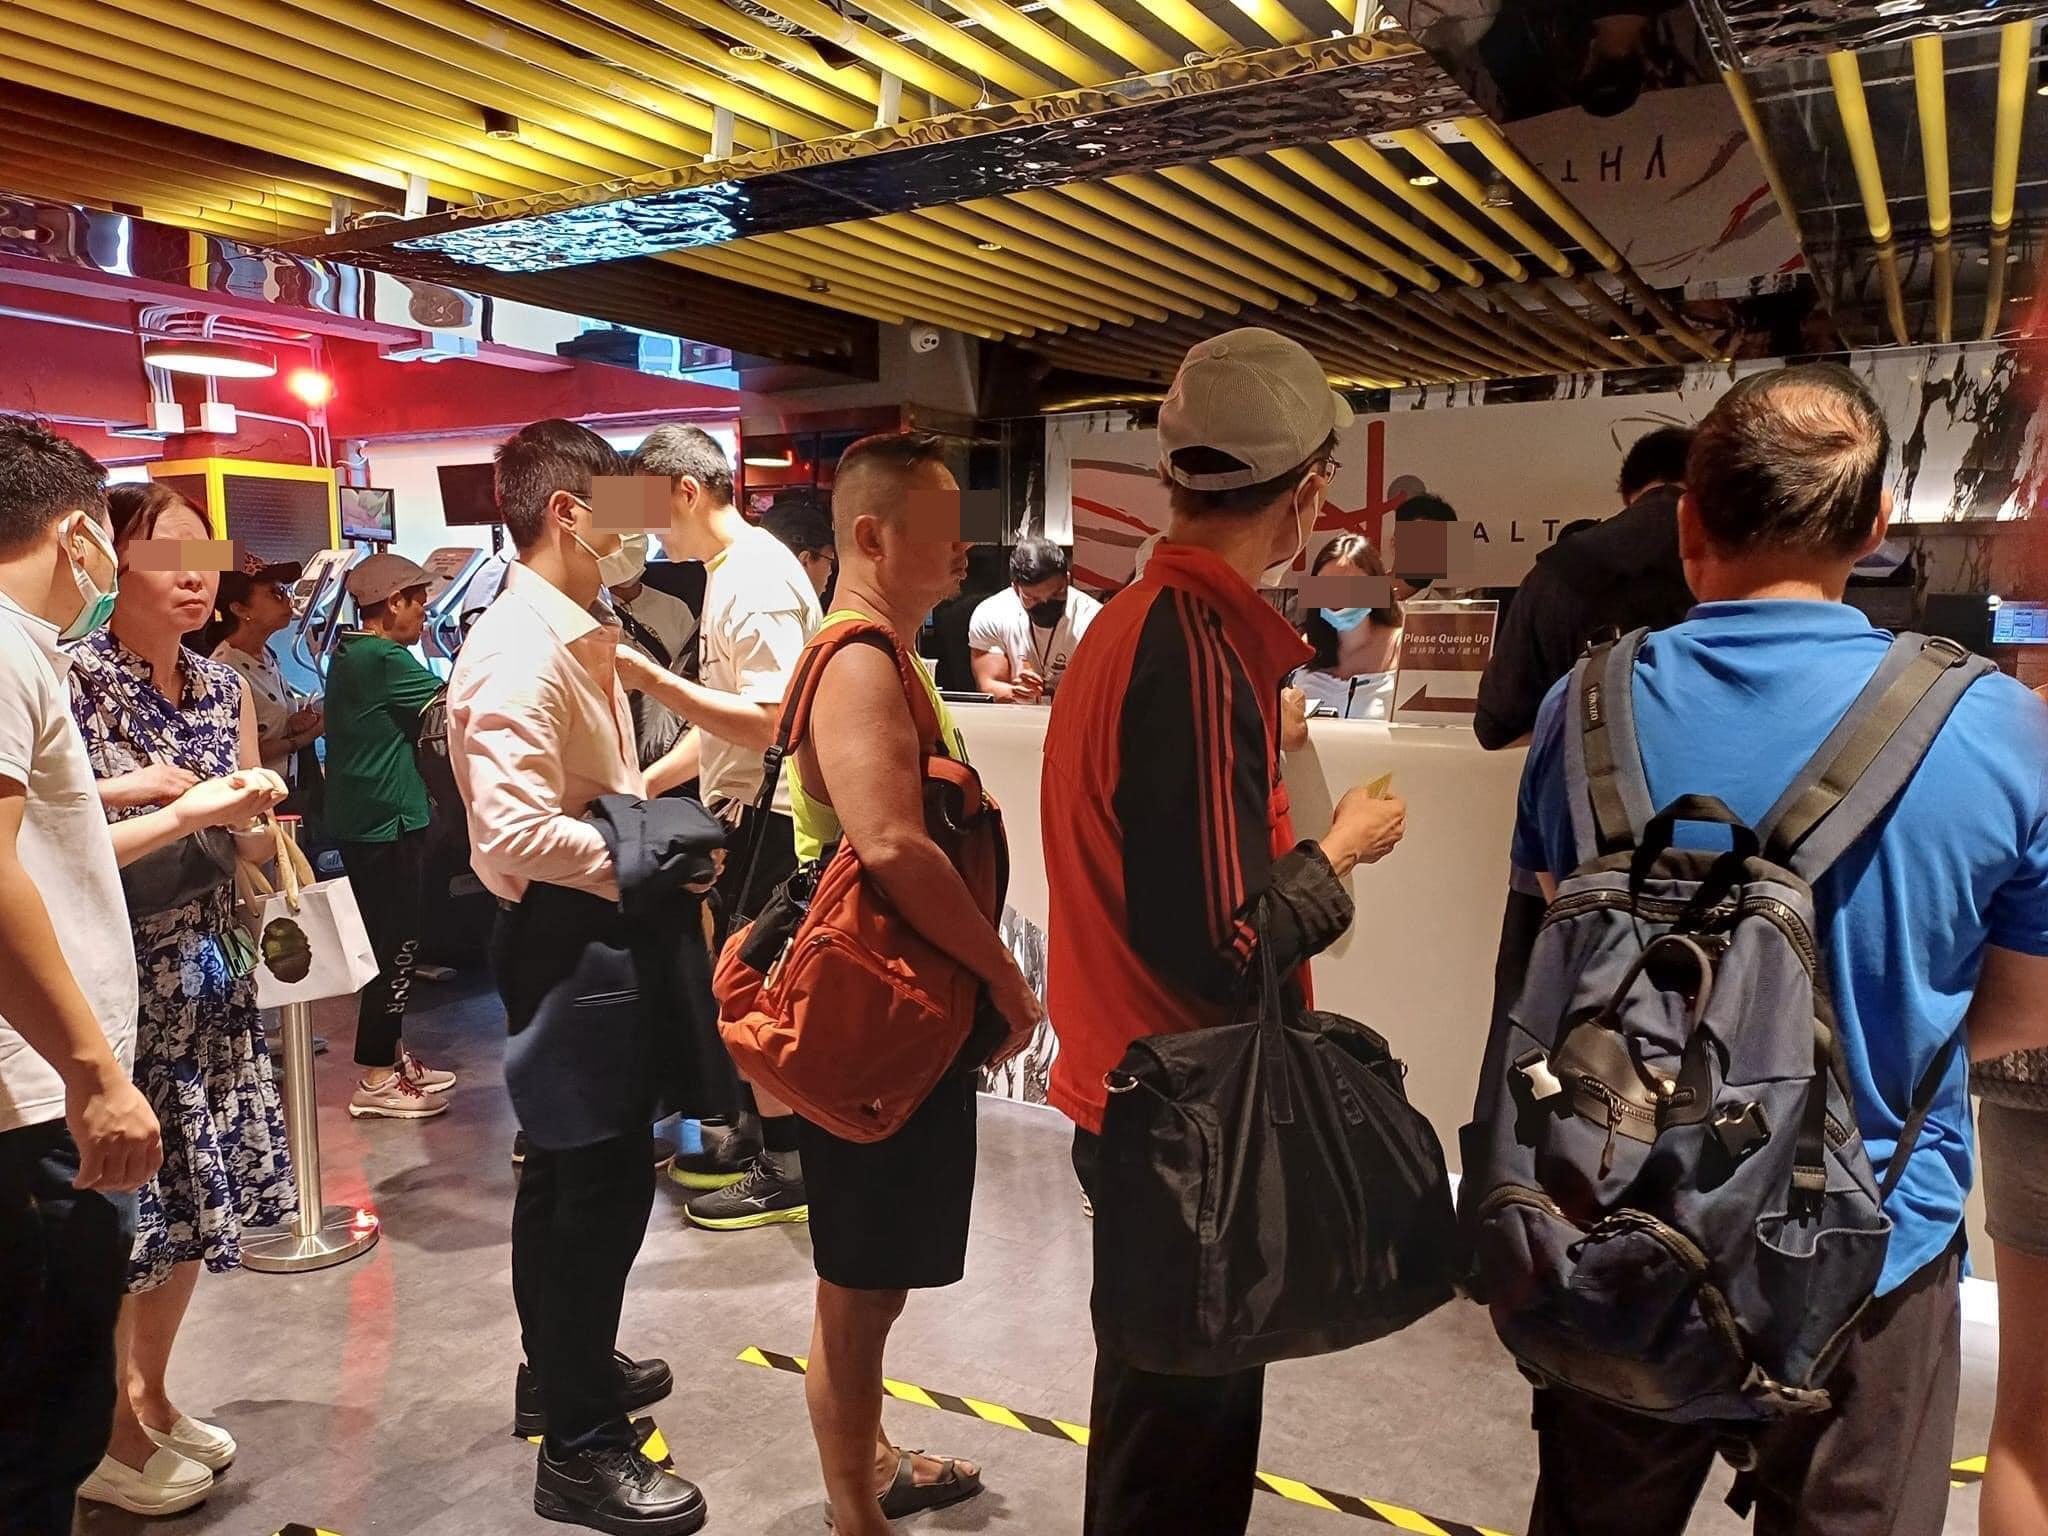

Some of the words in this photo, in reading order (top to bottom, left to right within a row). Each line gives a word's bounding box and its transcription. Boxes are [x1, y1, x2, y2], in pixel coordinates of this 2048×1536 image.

[1403, 632, 1437, 644] Please
[1438, 633, 1473, 645] Queue
[1474, 633, 1490, 646] Up
